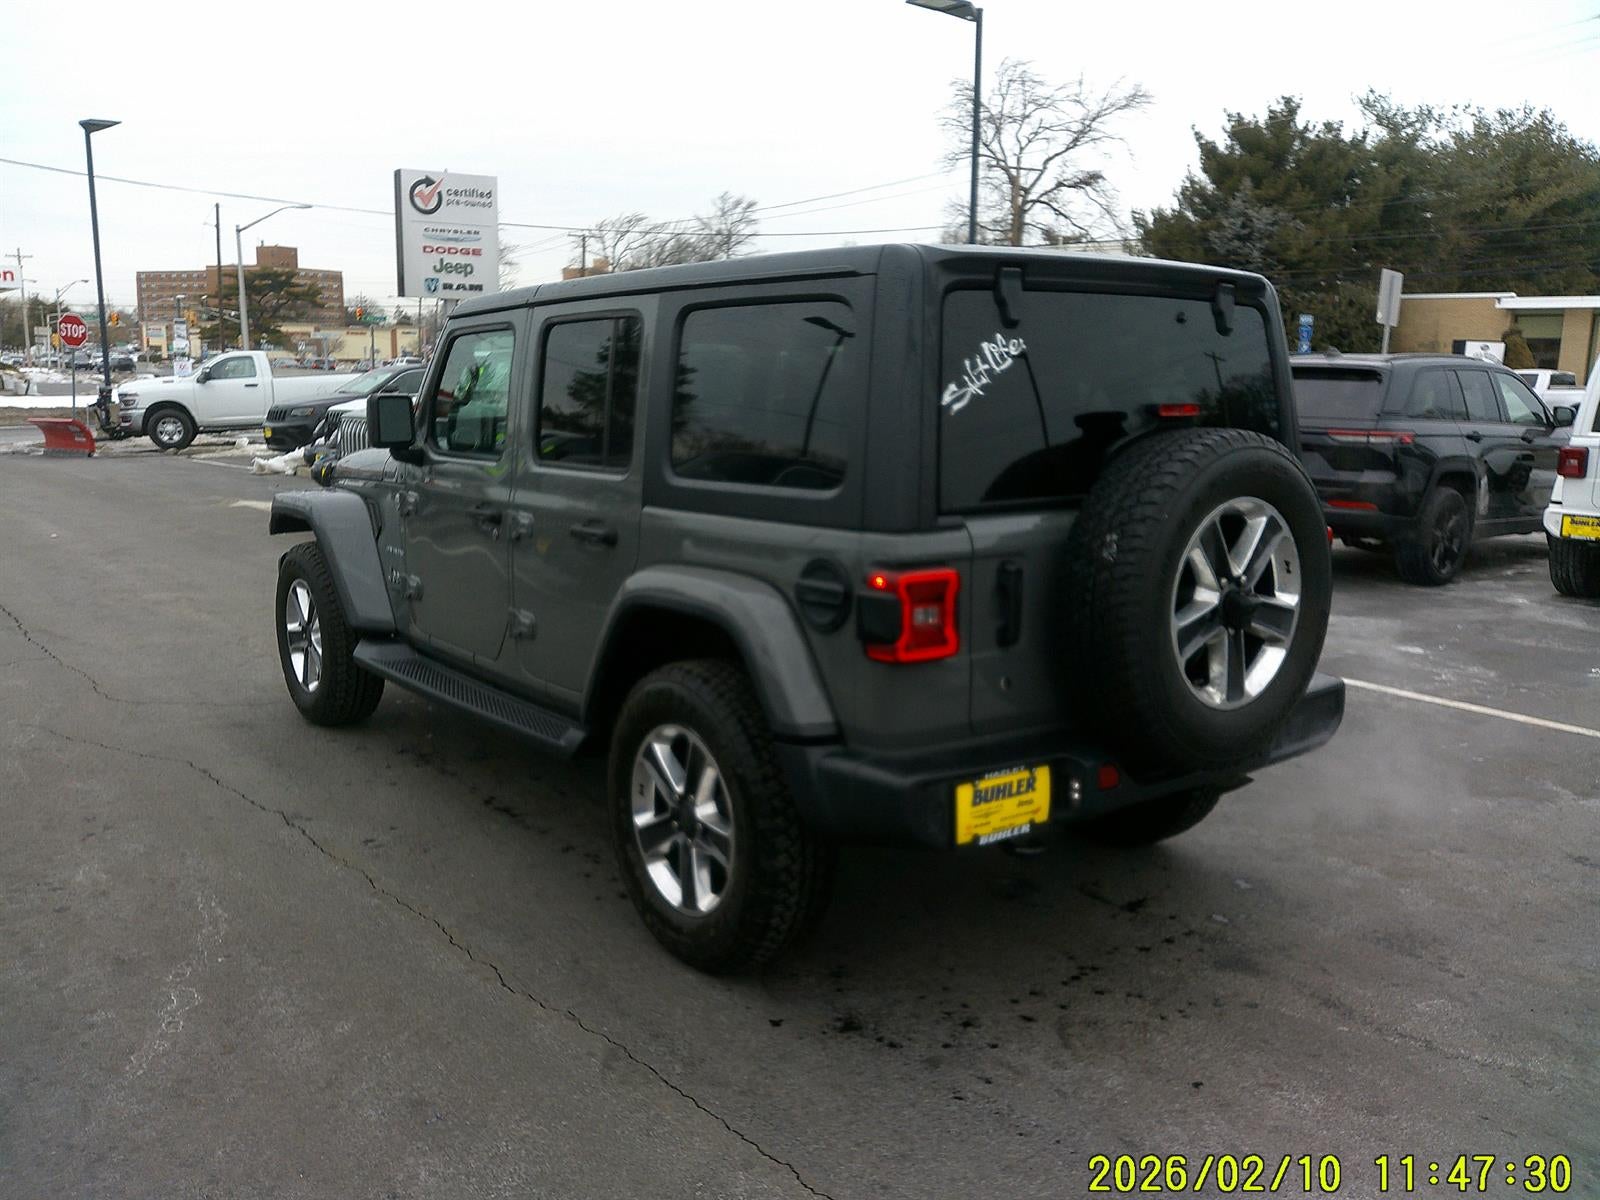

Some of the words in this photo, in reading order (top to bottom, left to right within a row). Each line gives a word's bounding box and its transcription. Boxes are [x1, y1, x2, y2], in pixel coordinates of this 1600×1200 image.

[446, 188, 492, 199] certified
[446, 198, 493, 208] pre-owned
[423, 227, 480, 235] CHRYSLER
[422, 245, 482, 256] DODGE
[433, 258, 474, 277] Jeep
[442, 282, 483, 292] RAM
[60, 322, 86, 338] STOP
[972, 774, 1037, 807] BUHLER
